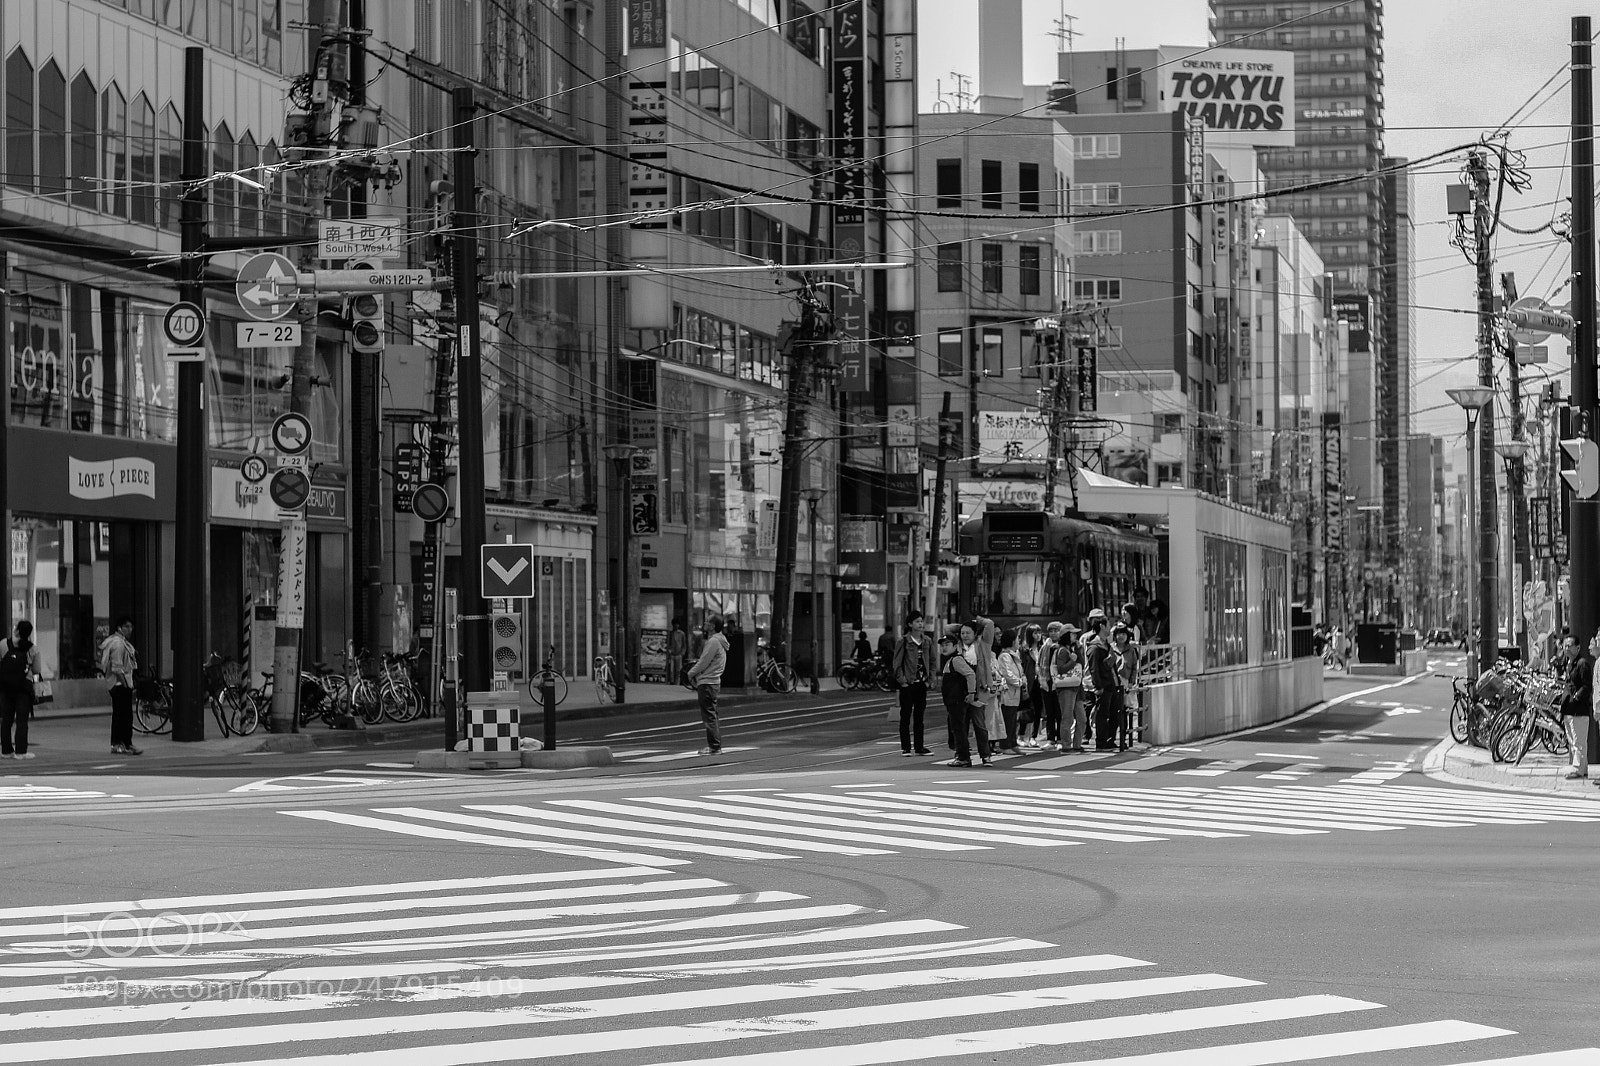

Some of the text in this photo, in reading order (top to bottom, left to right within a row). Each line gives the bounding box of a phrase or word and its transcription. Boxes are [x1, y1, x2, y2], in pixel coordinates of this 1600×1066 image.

[1182, 59, 1274, 72] CREATIVE LIFE STORE
[1171, 72, 1285, 102] TOKYU
[172, 315, 196, 335] 40
[397, 449, 411, 492] LIPS
[1325, 428, 1340, 484] HANDS
[78, 469, 150, 489] LOVE PIECE
[422, 561, 434, 602] LIPS
